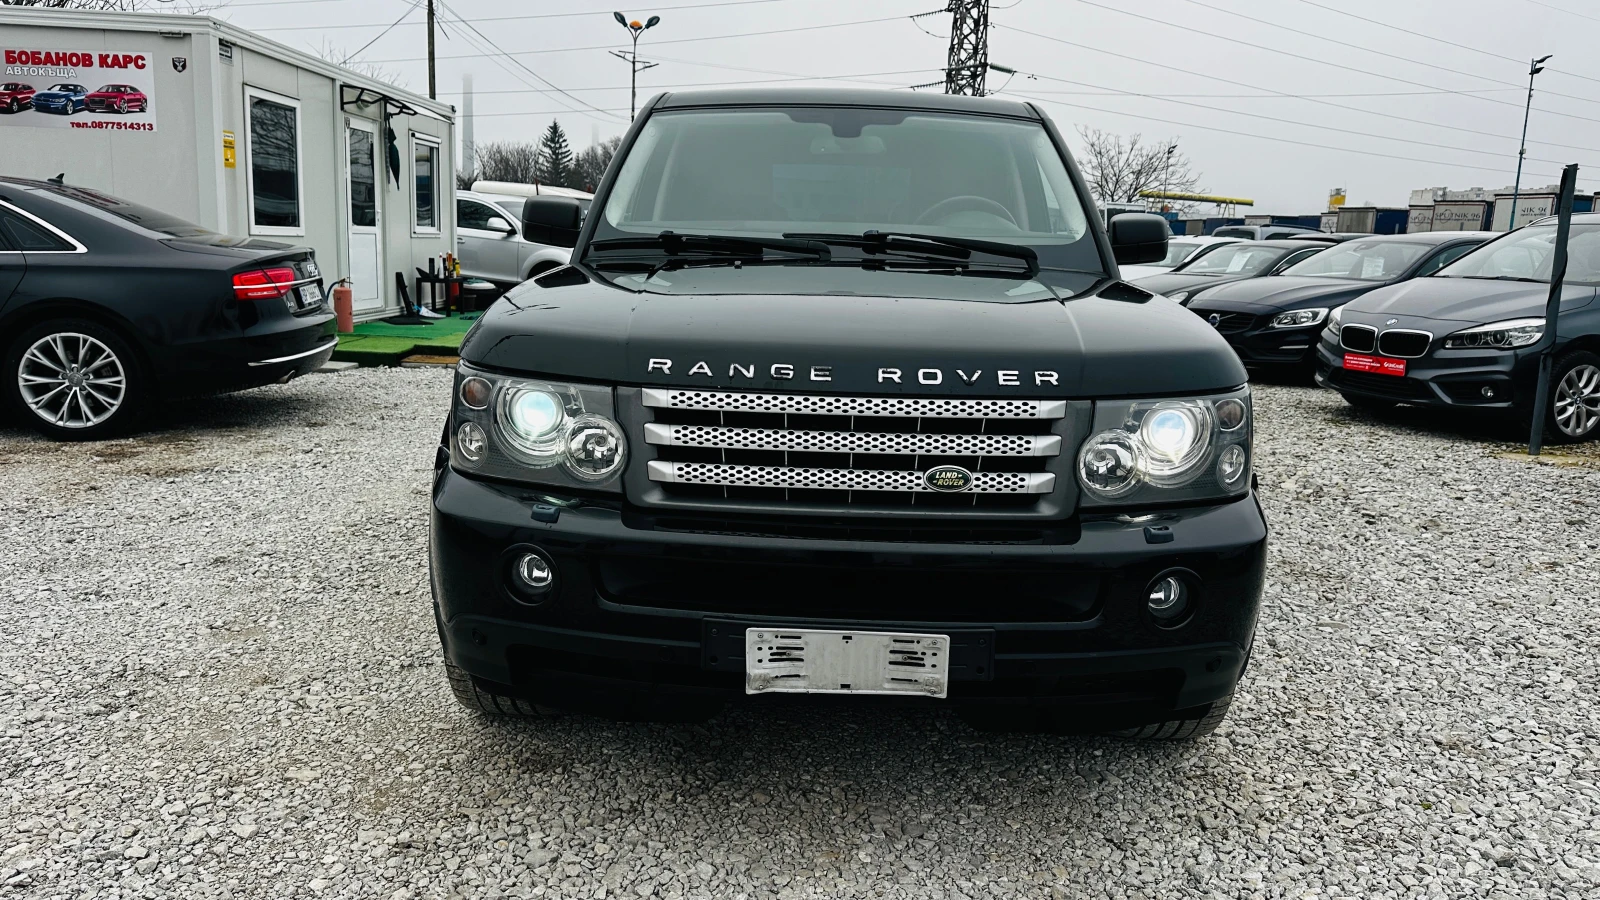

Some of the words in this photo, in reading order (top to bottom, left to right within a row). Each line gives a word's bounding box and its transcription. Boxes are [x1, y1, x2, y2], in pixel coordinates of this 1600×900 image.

[5, 50, 93, 68] БОБАНОВ
[98, 54, 146, 70] КАРС
[5, 66, 77, 79] АВТОКЪЩА
[70, 120, 154, 131] тел.0877514313
[647, 357, 833, 383] RANGE
[877, 366, 1061, 388] ROVER
